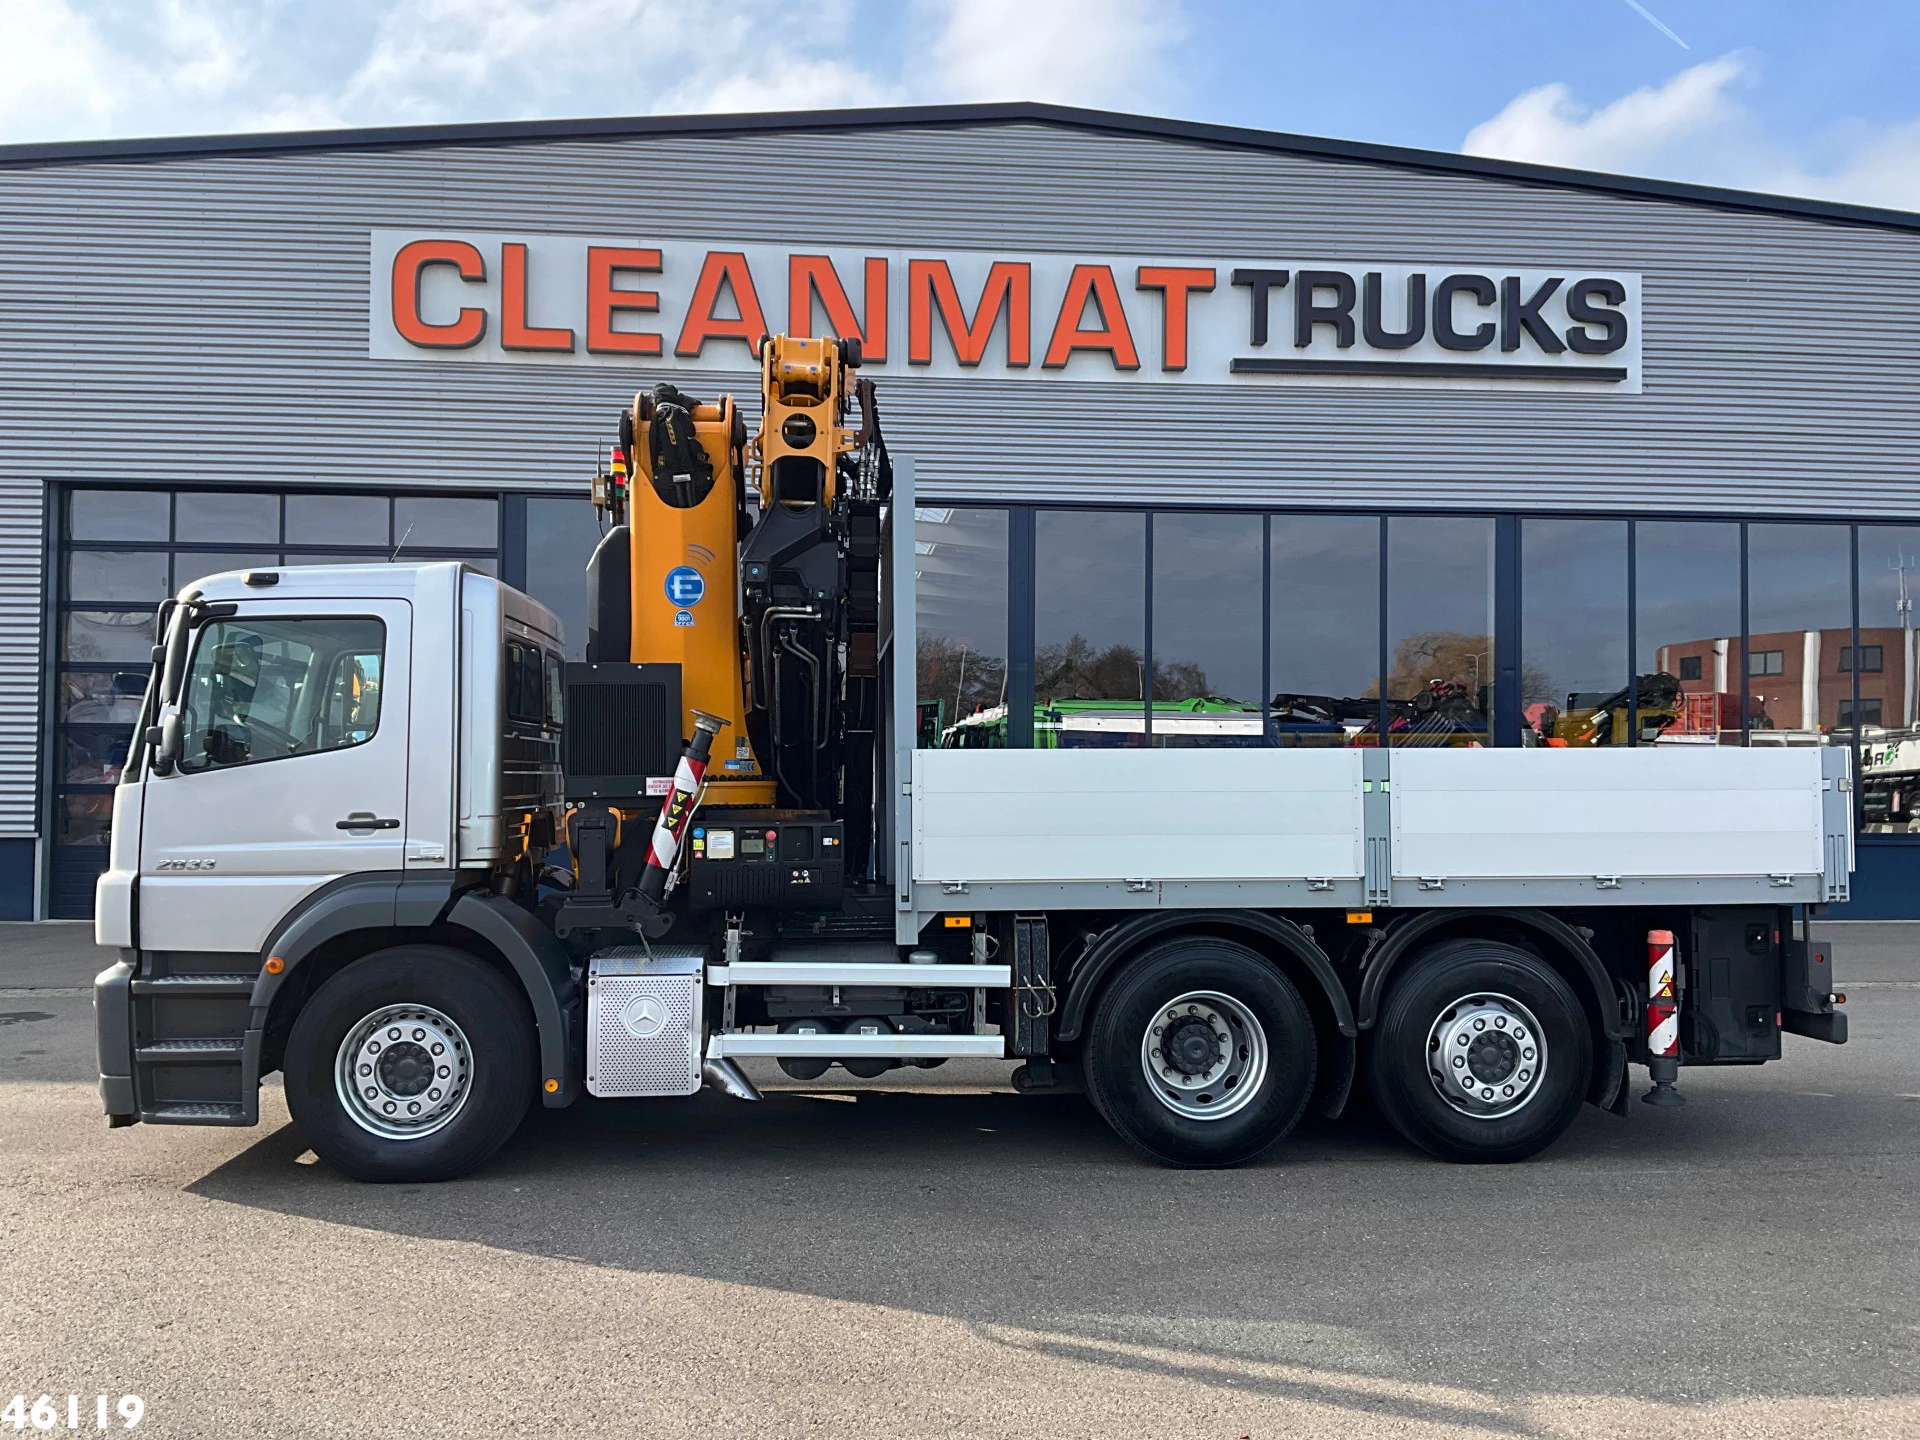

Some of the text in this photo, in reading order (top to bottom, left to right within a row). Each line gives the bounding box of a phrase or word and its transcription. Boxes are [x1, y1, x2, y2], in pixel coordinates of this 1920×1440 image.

[391, 239, 1628, 372] CLEANMAT TRUCKS
[155, 859, 216, 871] 2833
